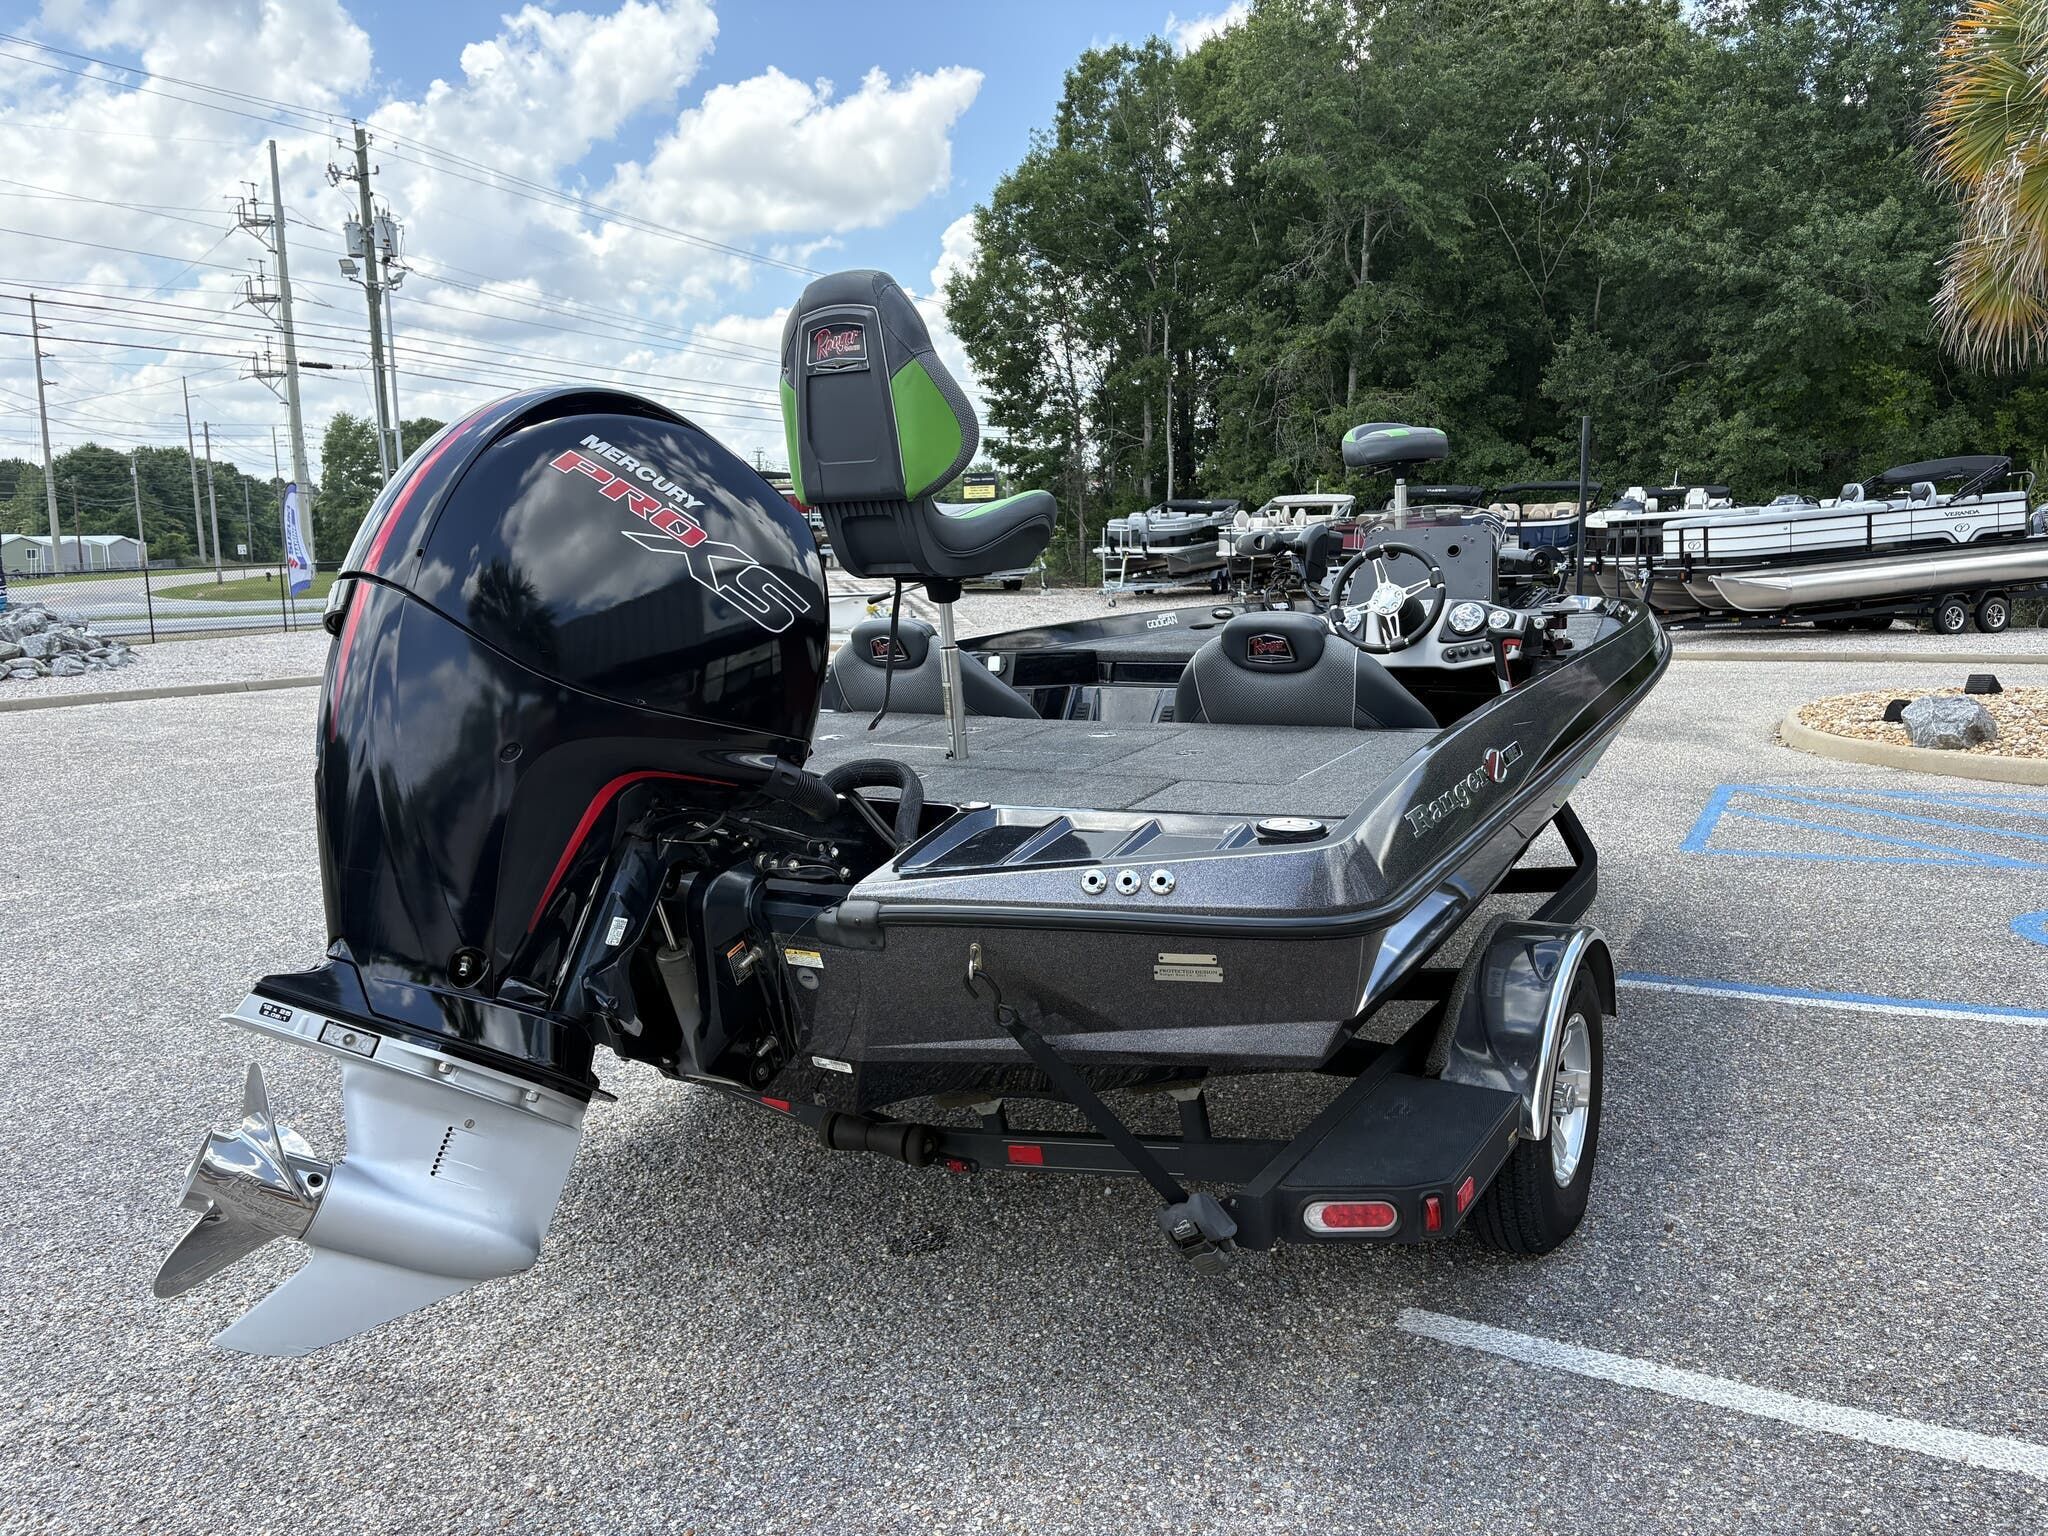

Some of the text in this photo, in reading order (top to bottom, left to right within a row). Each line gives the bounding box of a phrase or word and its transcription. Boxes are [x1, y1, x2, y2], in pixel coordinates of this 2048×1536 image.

[814, 329, 861, 360] Ranger
[580, 434, 705, 509] MERCURY
[1944, 509, 1980, 517] VERANDA
[550, 450, 811, 633] PRO XS
[1147, 615, 1178, 629] GOOGAN
[1404, 765, 1490, 839] Ranger
